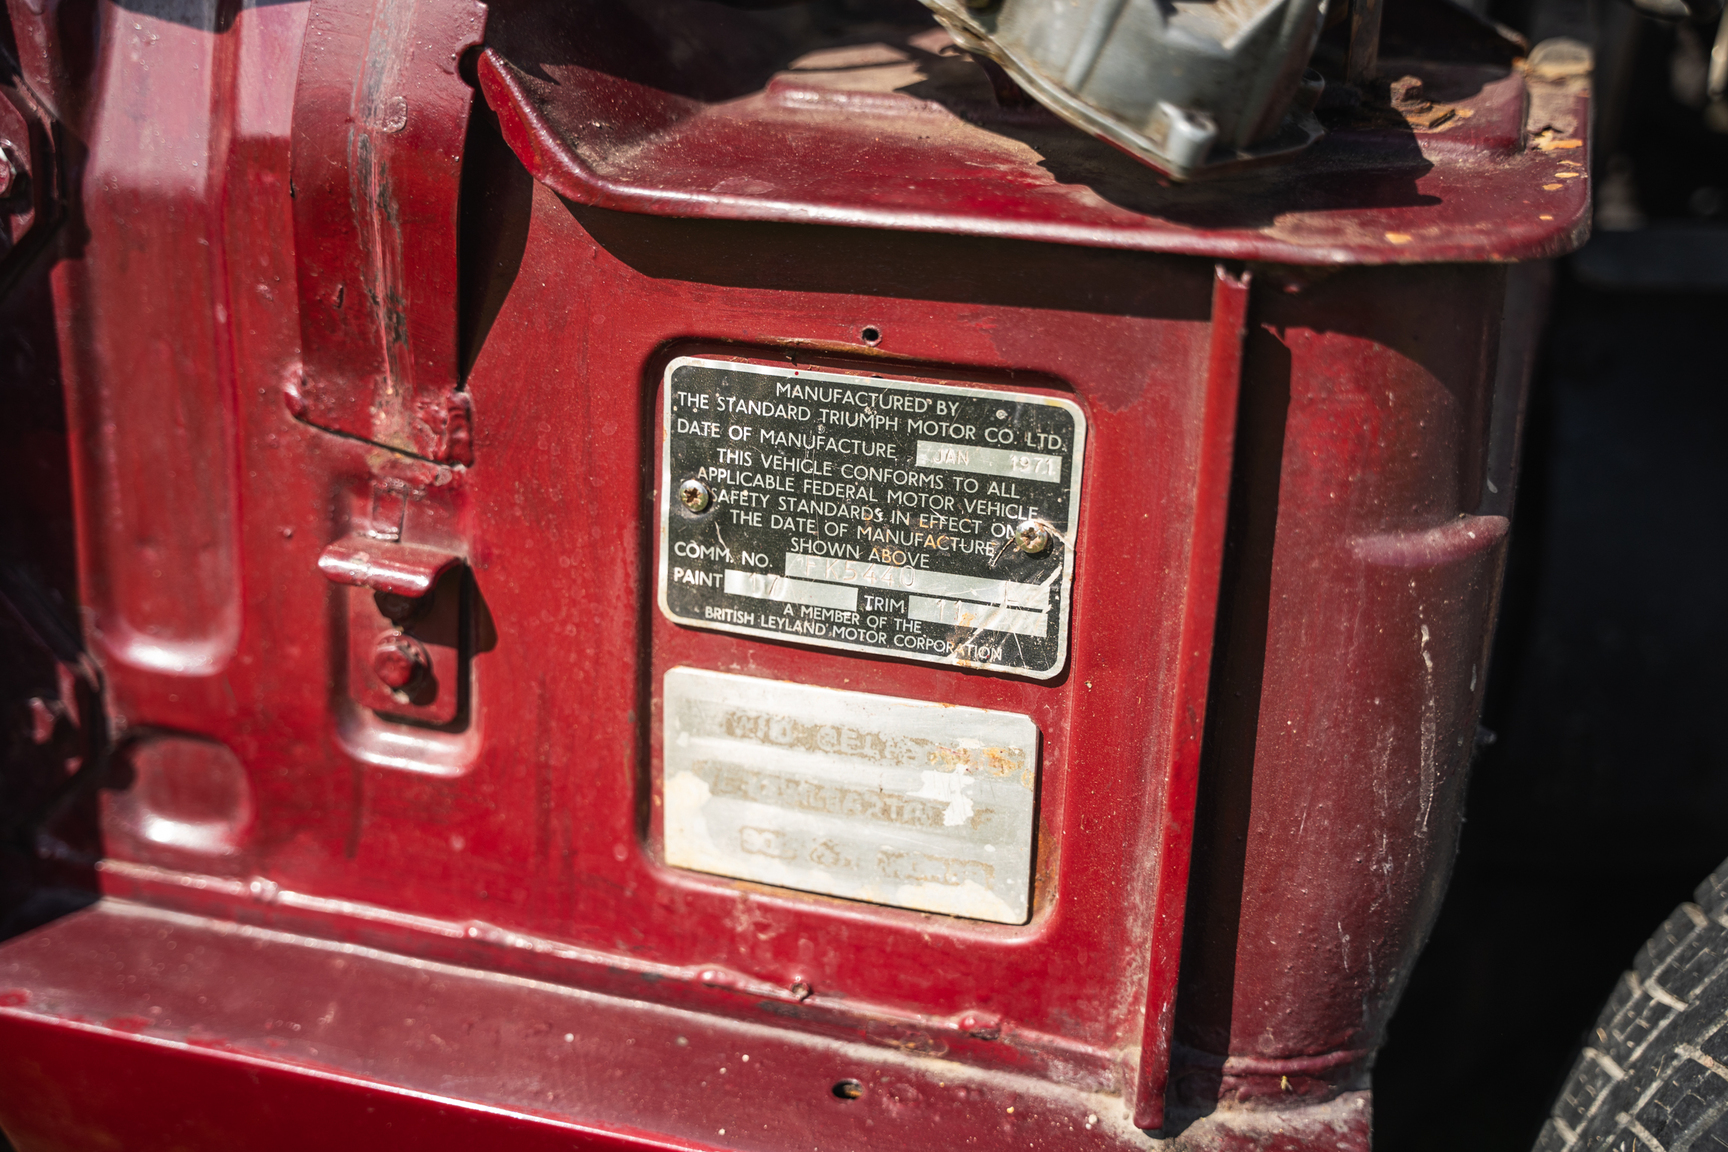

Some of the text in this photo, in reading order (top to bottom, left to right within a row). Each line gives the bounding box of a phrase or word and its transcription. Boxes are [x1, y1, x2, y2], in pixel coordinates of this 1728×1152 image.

[678, 391, 709, 410] THE
[717, 396, 811, 421] STANDARD
[819, 408, 899, 431] TRIUMPH
[907, 419, 976, 440] MOTOR
[776, 381, 959, 416] MANUFACTURED BY
[677, 418, 1057, 476] DATE OF MANUFACTURE JAN 1971
[698, 466, 1039, 521] APPLICABLE FEDERAL MOTOR VEHICLE
[717, 447, 1021, 499] THIS VEHICLE CONFORMS TO ALL
[711, 487, 770, 509] SAFETY
[778, 496, 884, 523] STANDARDS
[892, 510, 910, 526] IN
[919, 513, 982, 535] EFFECT
[730, 509, 995, 557] THE DATE OF MANUFACTURE
[674, 541, 734, 564] COMM.
[742, 551, 773, 568] NO.
[790, 536, 930, 569] SHOWN ABOVE
[673, 567, 723, 588] PAINT
[863, 595, 904, 614] TRIM
[705, 605, 1003, 662] BRITISH LEYLAND MOTOR CORPORATION
[783, 603, 922, 634] A MEMBER OF THE
